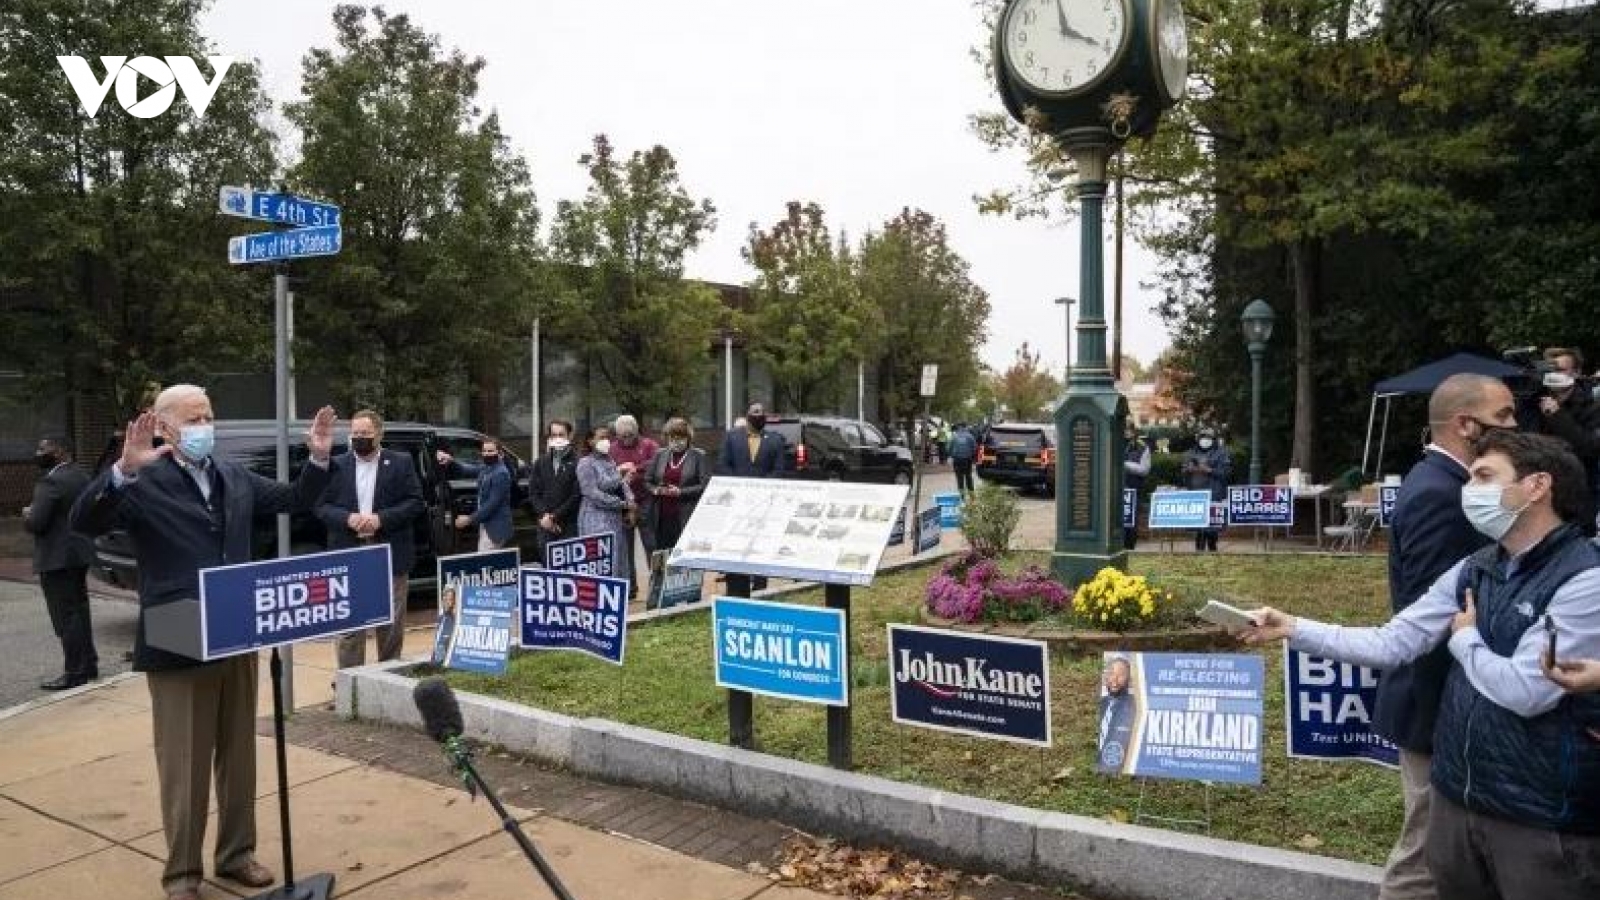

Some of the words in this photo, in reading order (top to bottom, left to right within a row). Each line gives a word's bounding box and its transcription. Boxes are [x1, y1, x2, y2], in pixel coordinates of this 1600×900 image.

[259, 197, 269, 217] E
[276, 201, 306, 223] 4th
[312, 207, 329, 227] St
[298, 233, 332, 254] States
[1231, 486, 1288, 502] BIDEN
[1231, 502, 1289, 514] HARRIS
[552, 537, 611, 567] BIDEN
[255, 575, 349, 612] BIDEN
[525, 575, 621, 612] BIDEN
[256, 600, 351, 635] HARRIS
[525, 602, 619, 638] HARRIS
[725, 629, 831, 671] SCANLON
[896, 648, 962, 685] John
[965, 657, 1042, 697] Kane
[1158, 669, 1251, 685] RE-ELECTING
[1147, 709, 1258, 750] KIRKLAND
[1311, 732, 1339, 744] Text
